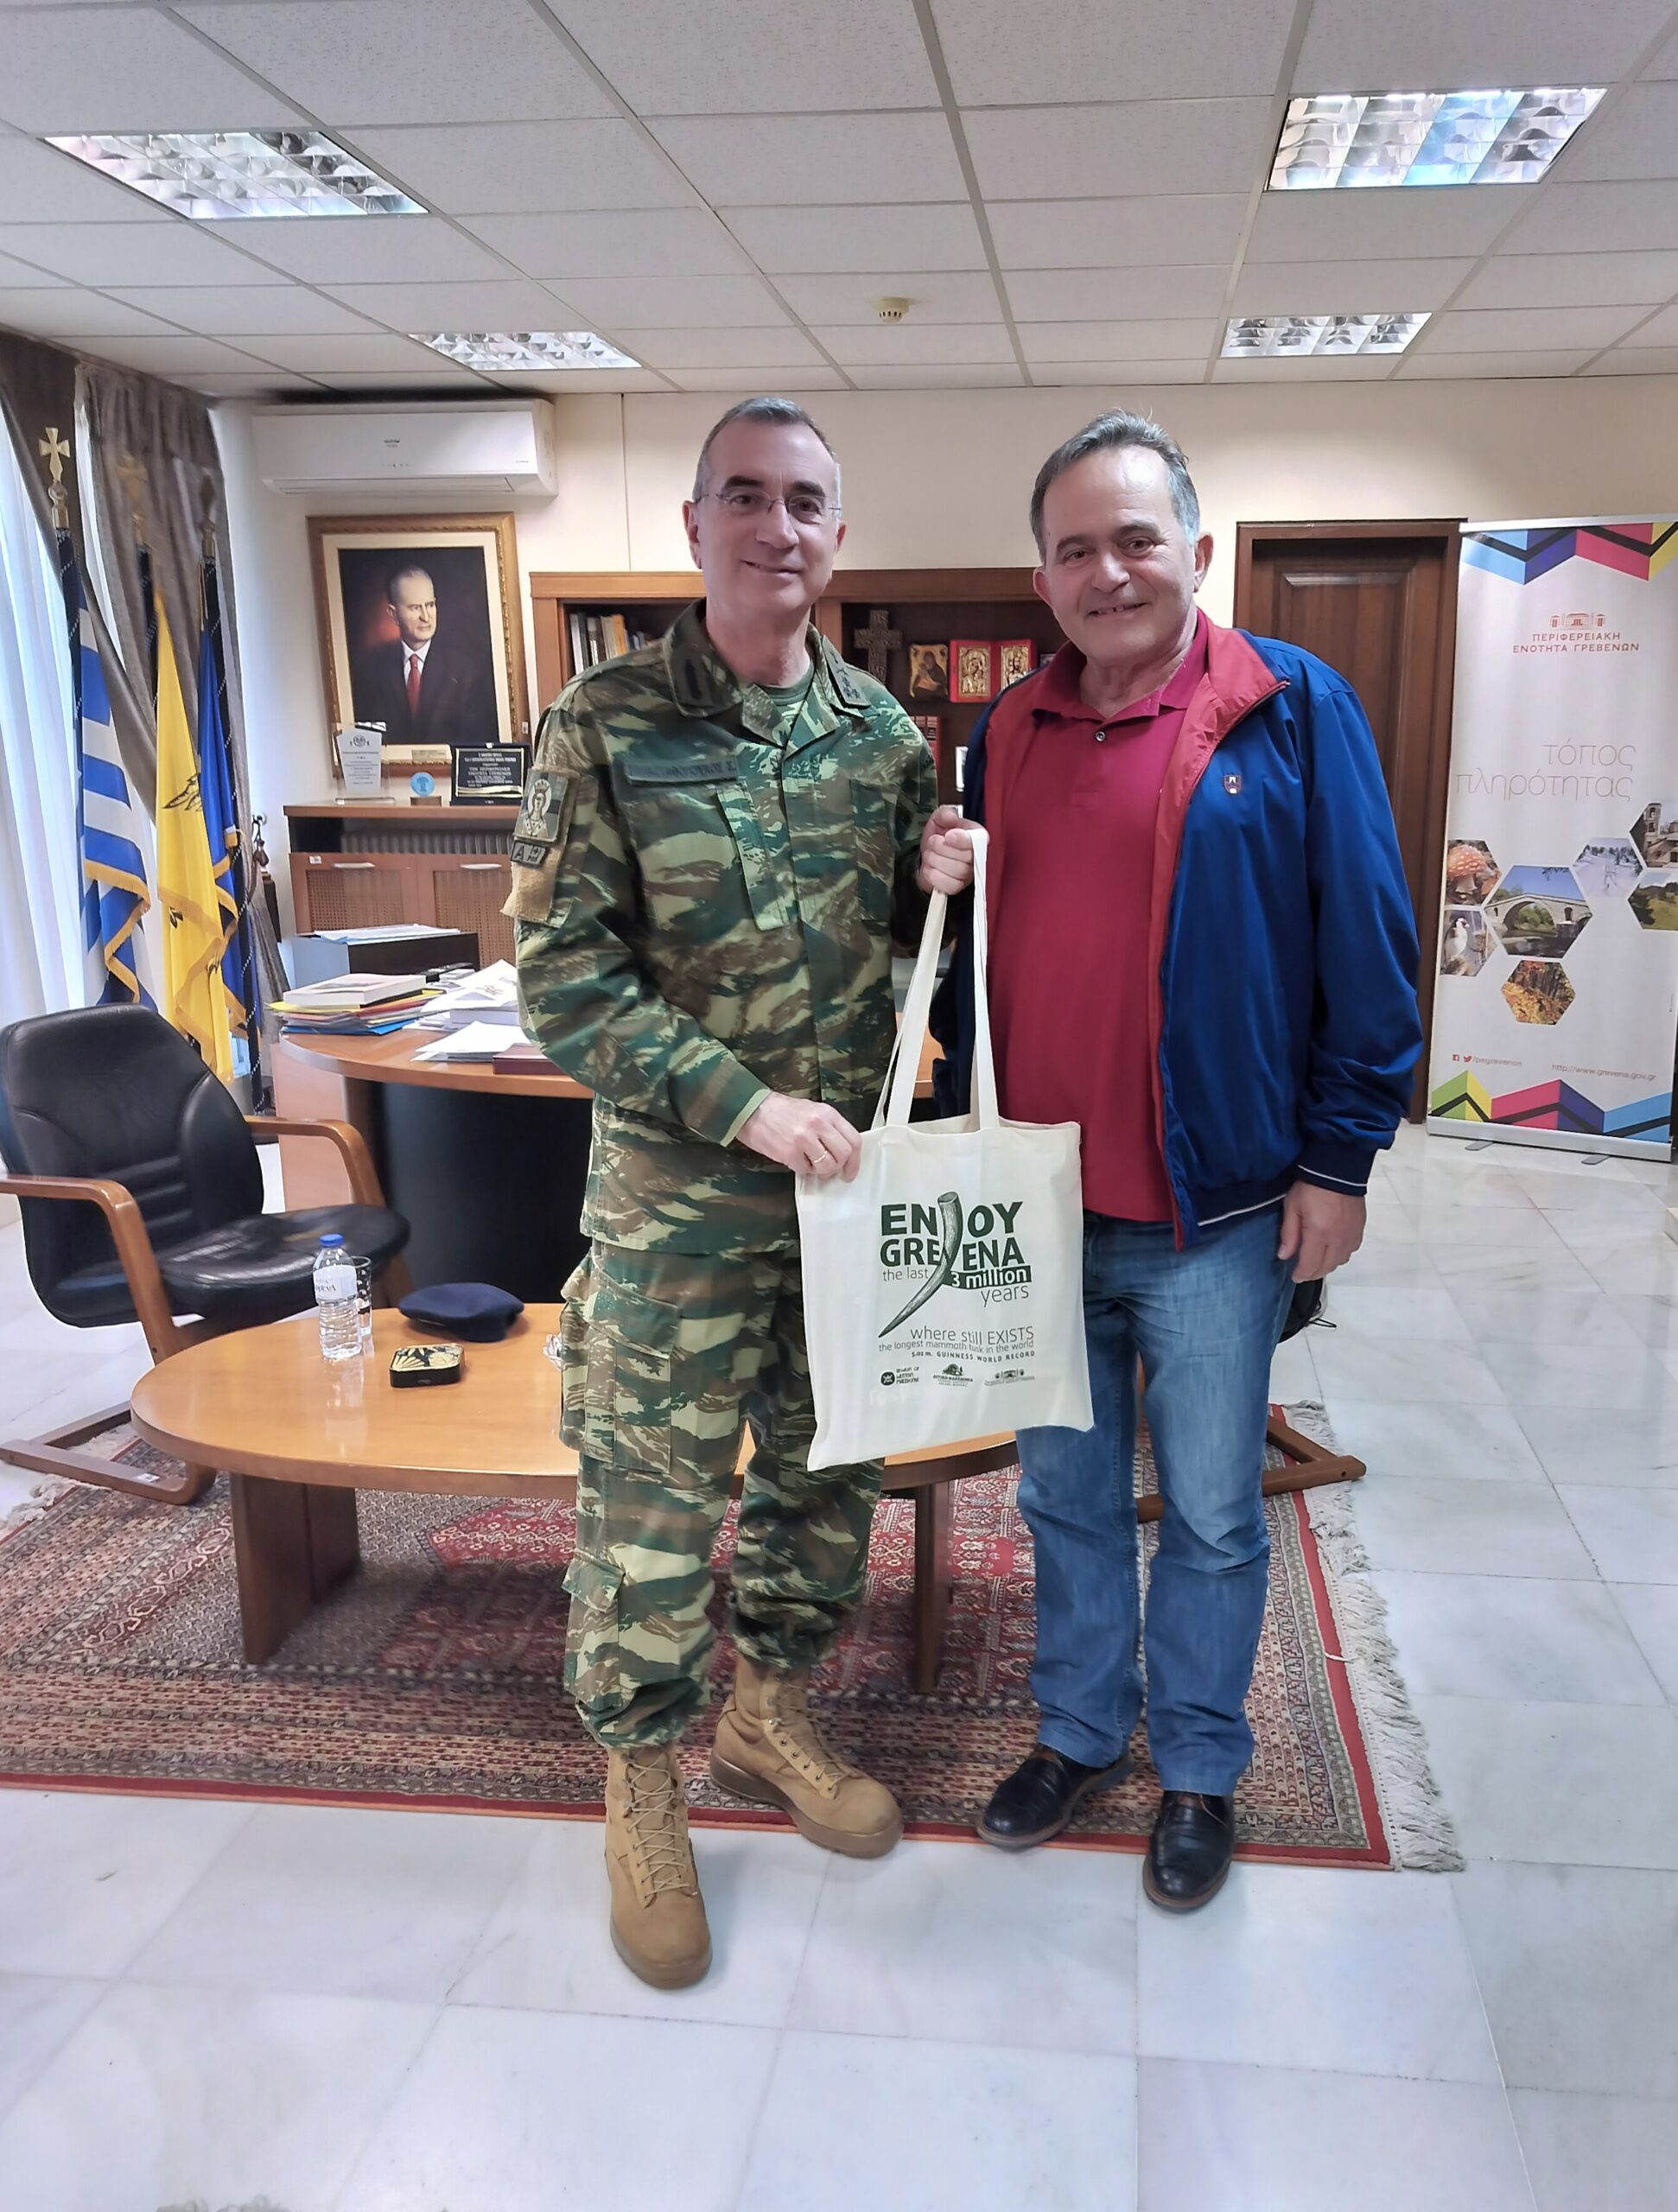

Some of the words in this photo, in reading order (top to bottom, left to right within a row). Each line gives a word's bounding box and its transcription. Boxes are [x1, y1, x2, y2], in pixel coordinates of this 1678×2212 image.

[1532, 632, 1621, 642] ΠΕΡΙΦΕΡΕΙΑΚΗ
[1512, 645, 1568, 653] ΕΝΟΤΗΤΑ
[1573, 643, 1640, 652] ΓΡΕΒΕΝΩΝ
[1542, 738, 1637, 772] τόπος
[1456, 767, 1634, 802] πληρότητας
[881, 1197, 1024, 1237] ENJOY
[882, 1268, 903, 1281] the
[906, 1267, 929, 1279] last
[950, 1272, 961, 1287] 3
[966, 1268, 1027, 1288] million
[981, 1285, 1029, 1308] years
[910, 1325, 957, 1341] where
[961, 1330, 982, 1345] still
[988, 1325, 1034, 1345] EXISTS
[879, 1343, 893, 1352] the
[894, 1340, 924, 1350] longest
[925, 1341, 967, 1350] mammoth
[969, 1344, 984, 1353] tusk
[986, 1344, 994, 1354] in
[1011, 1339, 1034, 1350] world
[936, 1350, 974, 1361] GUINNESS
[1005, 1350, 1035, 1360] RECORD
